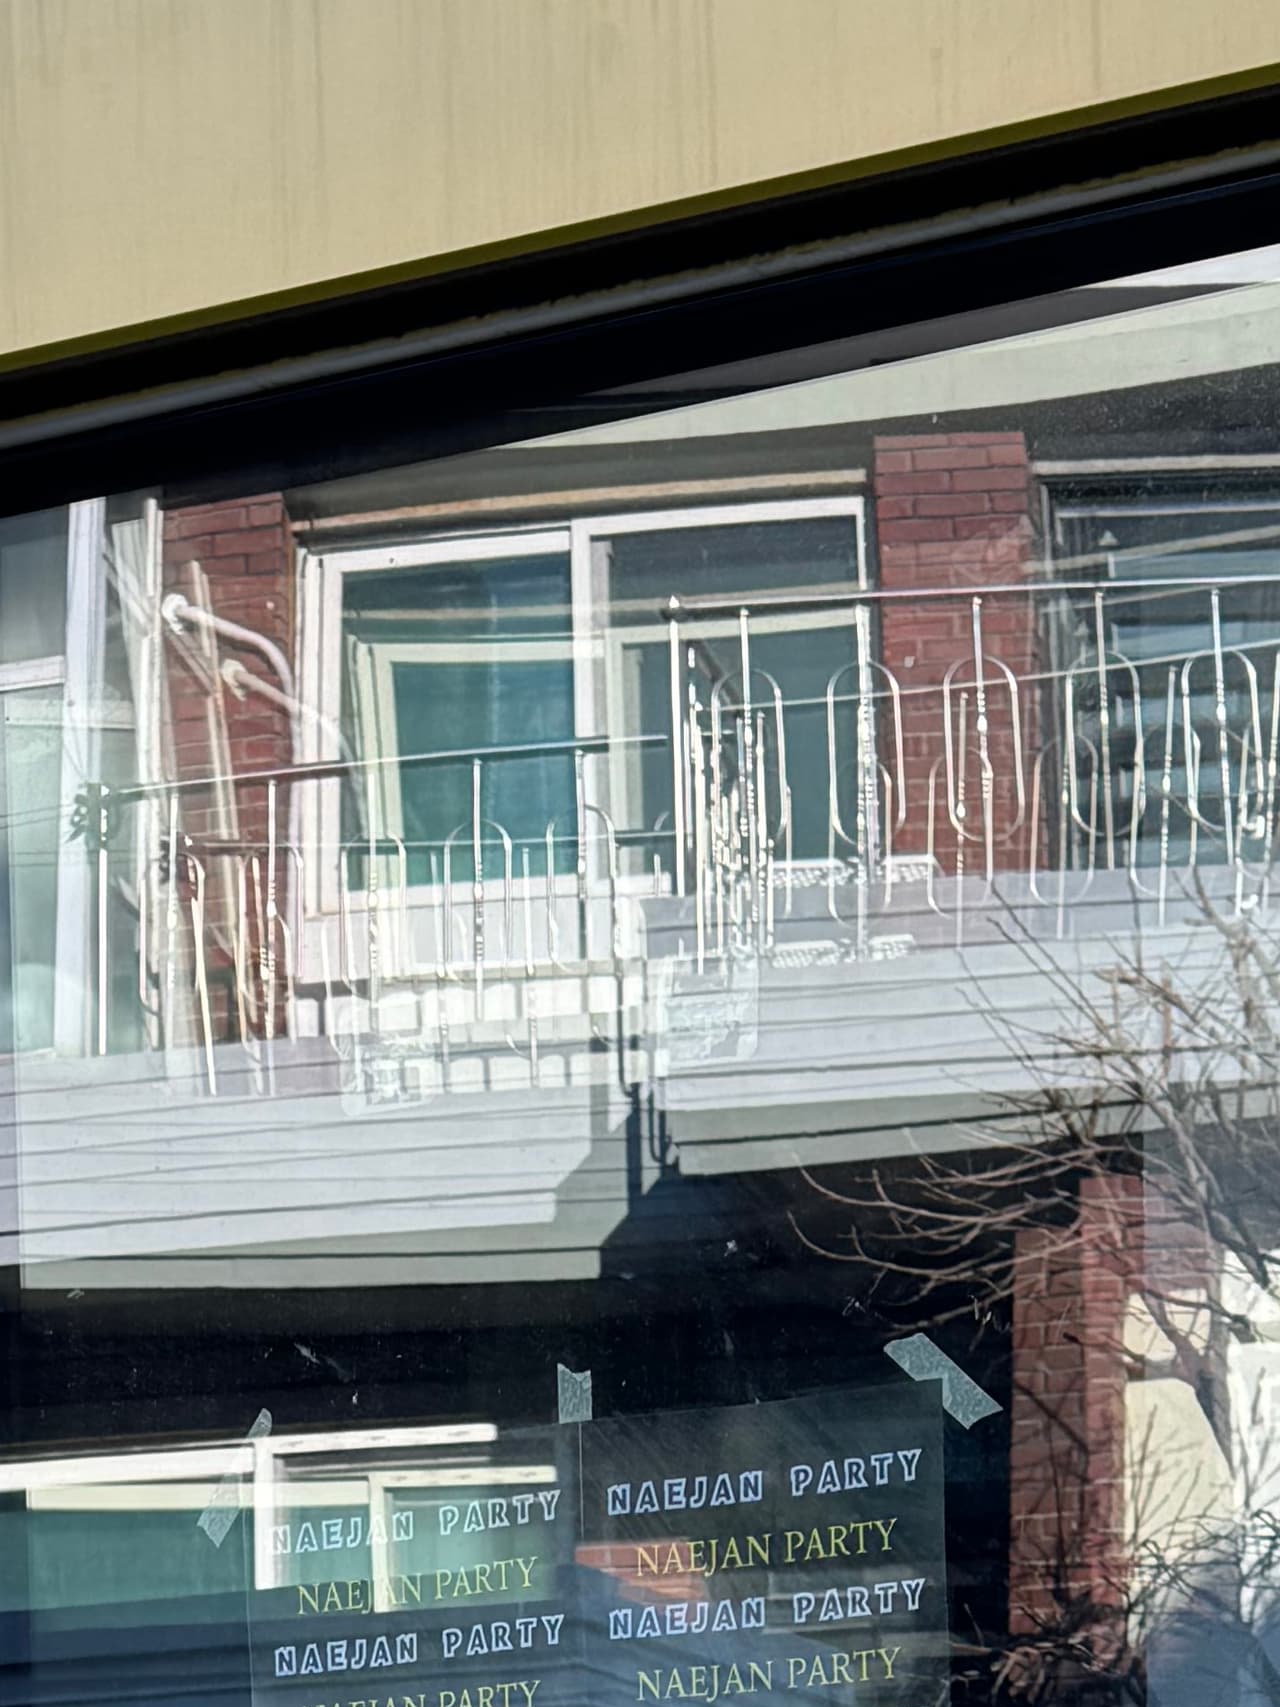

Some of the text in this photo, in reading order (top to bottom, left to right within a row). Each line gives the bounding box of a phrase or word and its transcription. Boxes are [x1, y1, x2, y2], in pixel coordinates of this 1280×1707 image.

[607, 1449, 922, 1517] NAEJAN PARTY
[441, 1490, 560, 1536] PARTY
[637, 1518, 897, 1577] NAEJAN PARTY
[433, 1557, 538, 1602] PARTY
[608, 1579, 925, 1640] NAEJAN PARTY
[275, 1614, 564, 1678] NAEJAN PARTY
[638, 1647, 902, 1702] NAEJAN PARTY
